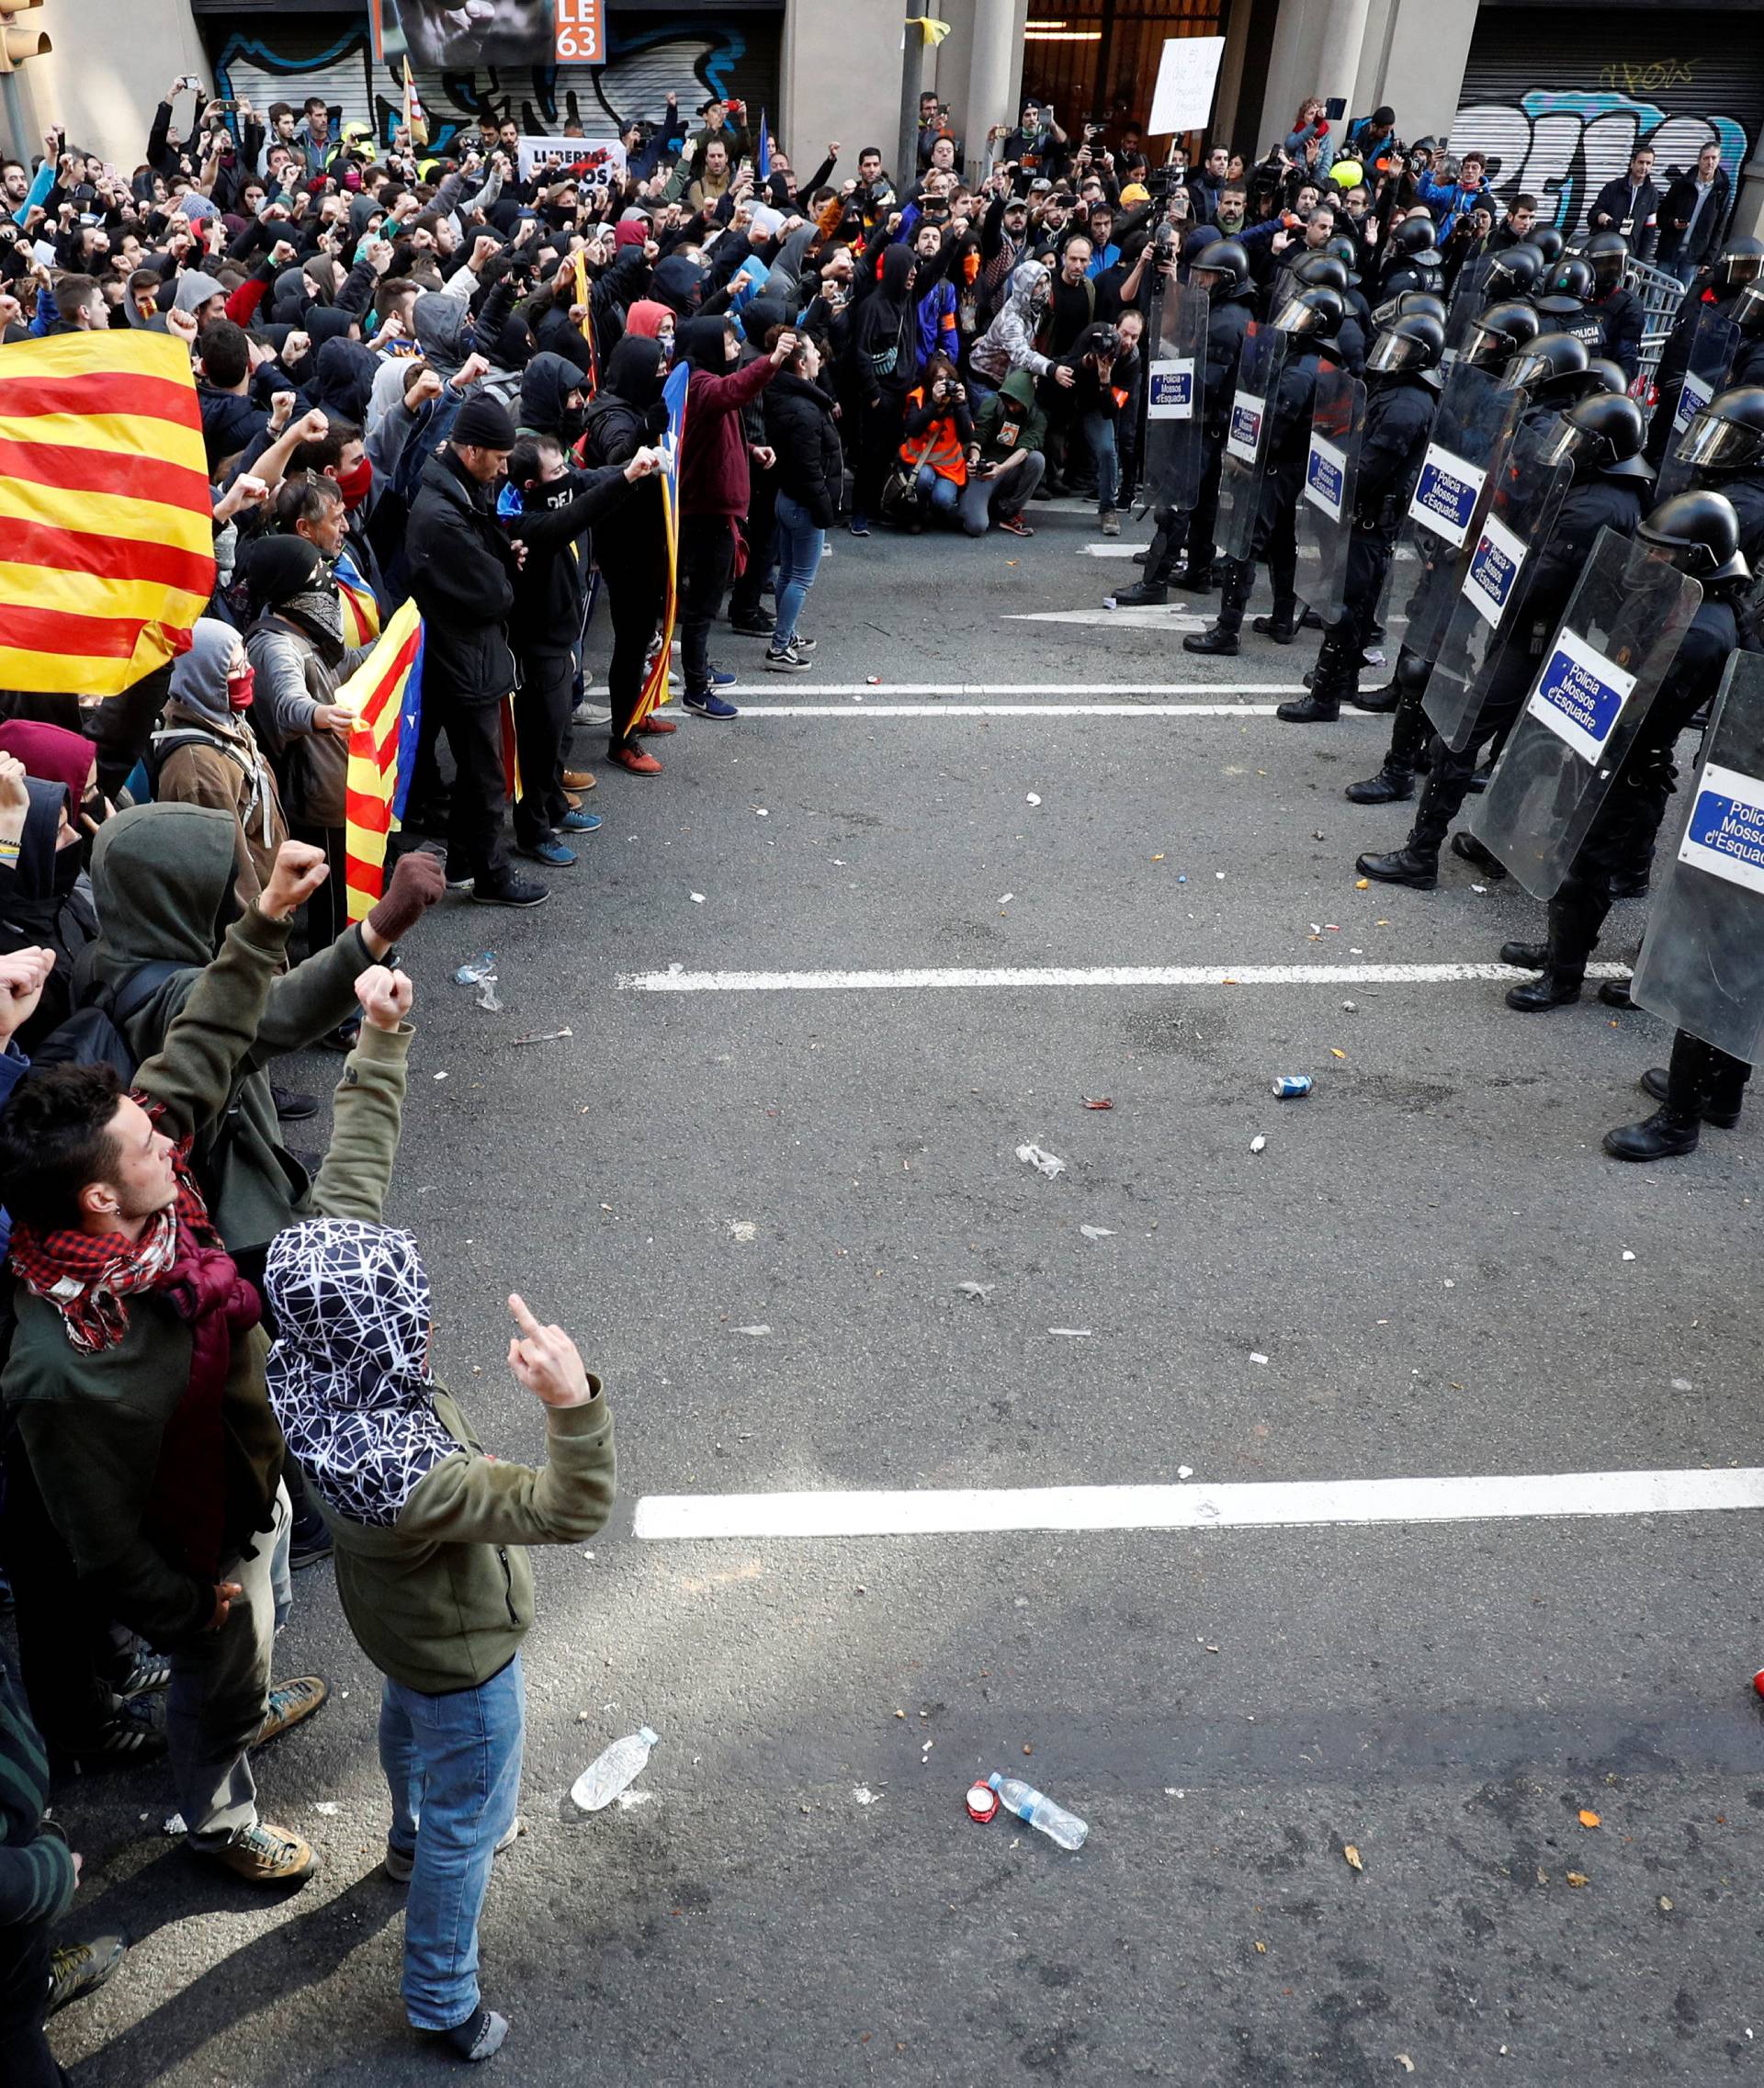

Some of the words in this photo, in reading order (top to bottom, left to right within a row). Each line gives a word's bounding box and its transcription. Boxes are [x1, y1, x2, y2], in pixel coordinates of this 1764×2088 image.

[559, 0, 595, 23] LE
[557, 26, 596, 57] 63
[1160, 384, 1182, 393] Mossos
[1431, 481, 1459, 506] Mossos
[1437, 470, 1462, 493] Policia
[1560, 674, 1597, 711] Mossos
[1569, 663, 1600, 695] Policia
[1705, 829, 1764, 865] d'Esqua
